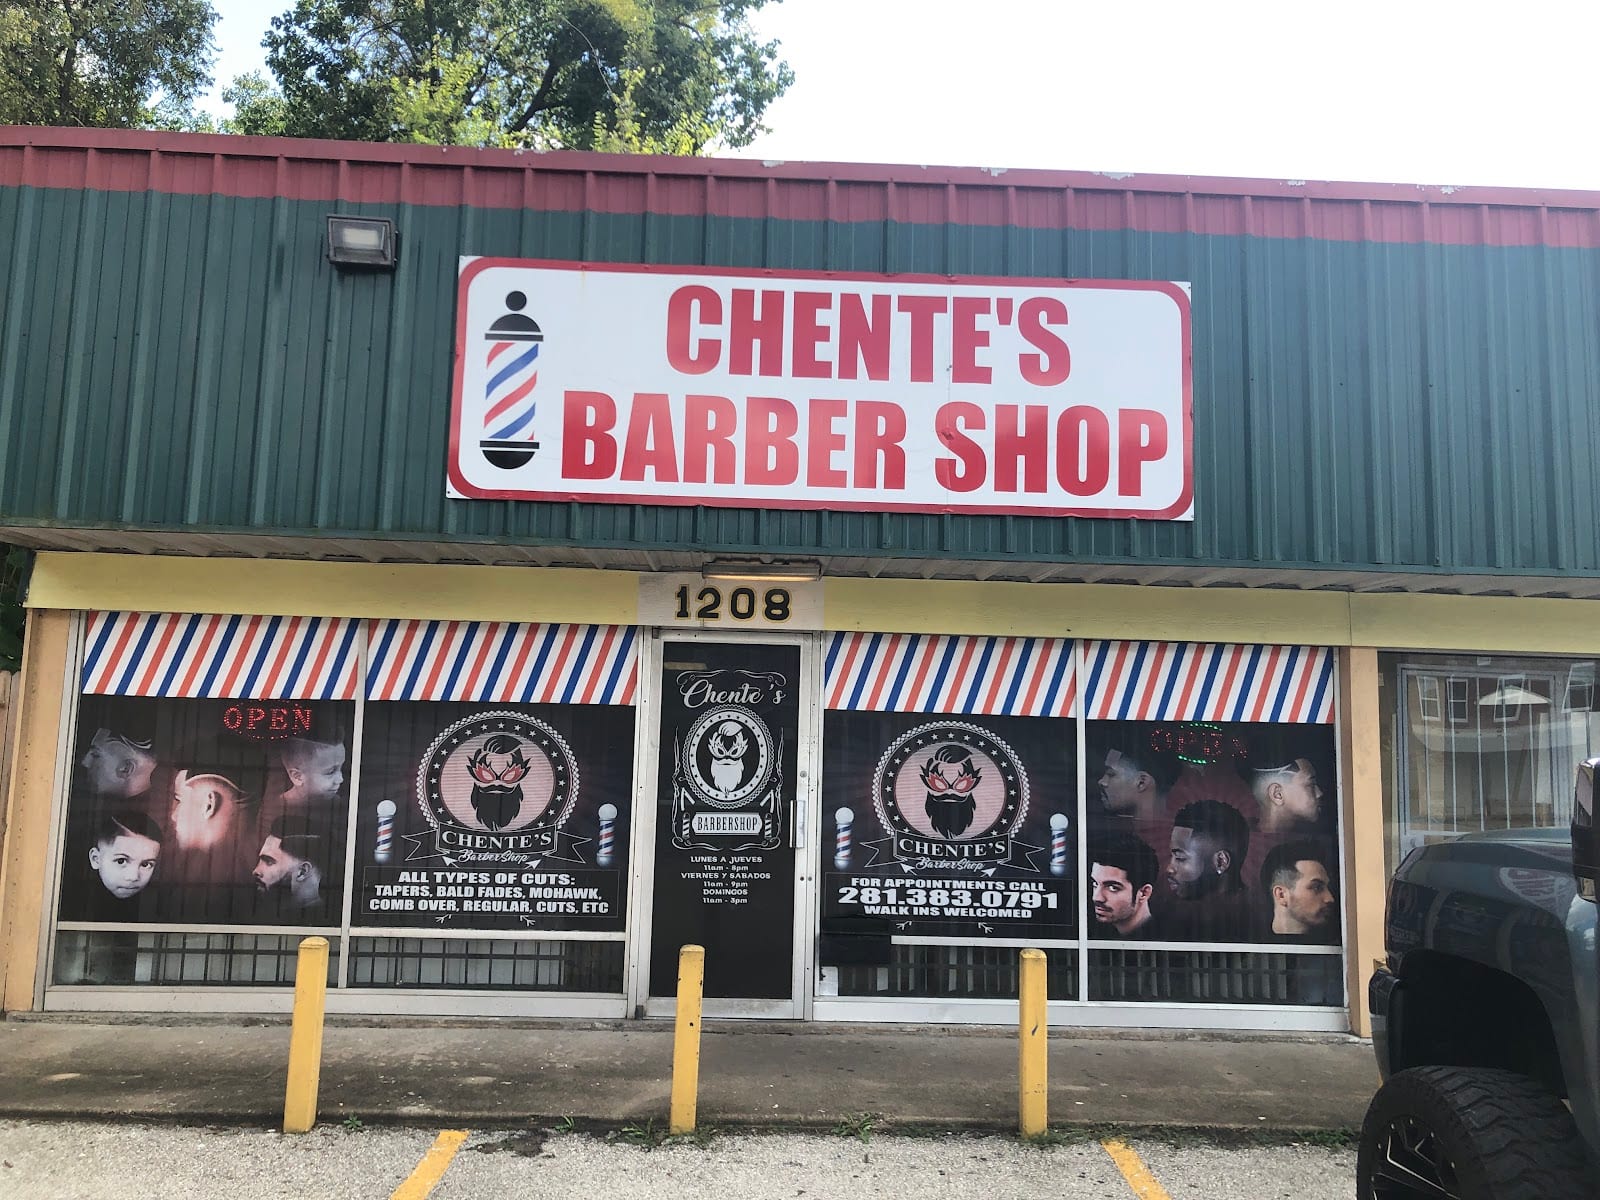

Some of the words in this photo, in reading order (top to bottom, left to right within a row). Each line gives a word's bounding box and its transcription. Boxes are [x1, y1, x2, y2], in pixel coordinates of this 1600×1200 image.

[665, 284, 1071, 387] CHENTE'S
[560, 390, 907, 490] BARBER
[934, 401, 1168, 497] SHOP
[675, 585, 791, 621] 1208
[680, 679, 786, 708] Chente's
[223, 706, 312, 731] OPEN
[697, 816, 758, 832] BARBERSHOP
[441, 830, 552, 849] CHENTE'S
[899, 838, 1006, 857] CHENTE'S
[729, 856, 763, 864] JUEVES
[398, 871, 429, 883] ALL
[433, 872, 490, 884] TYPES
[495, 873, 517, 884] OF
[521, 873, 575, 885] CUTS:
[851, 877, 880, 887] FOR
[884, 878, 1005, 890] APPOINTMENTS
[1009, 882, 1046, 891] CALL
[374, 885, 433, 898] TAPERS,
[436, 886, 474, 897] BALD
[477, 886, 526, 899] FADES,
[529, 887, 602, 900] MOHAWK,
[838, 886, 1058, 909] 281.383.0791
[369, 899, 414, 910] COMB
[418, 899, 460, 912] OVER,
[463, 900, 533, 913] REGULAR,
[536, 901, 579, 914] CUTS,
[582, 902, 609, 913] ETC
[864, 905, 910, 915] WALK
[913, 906, 940, 916] INS
[943, 907, 1032, 918] WELCOMED
